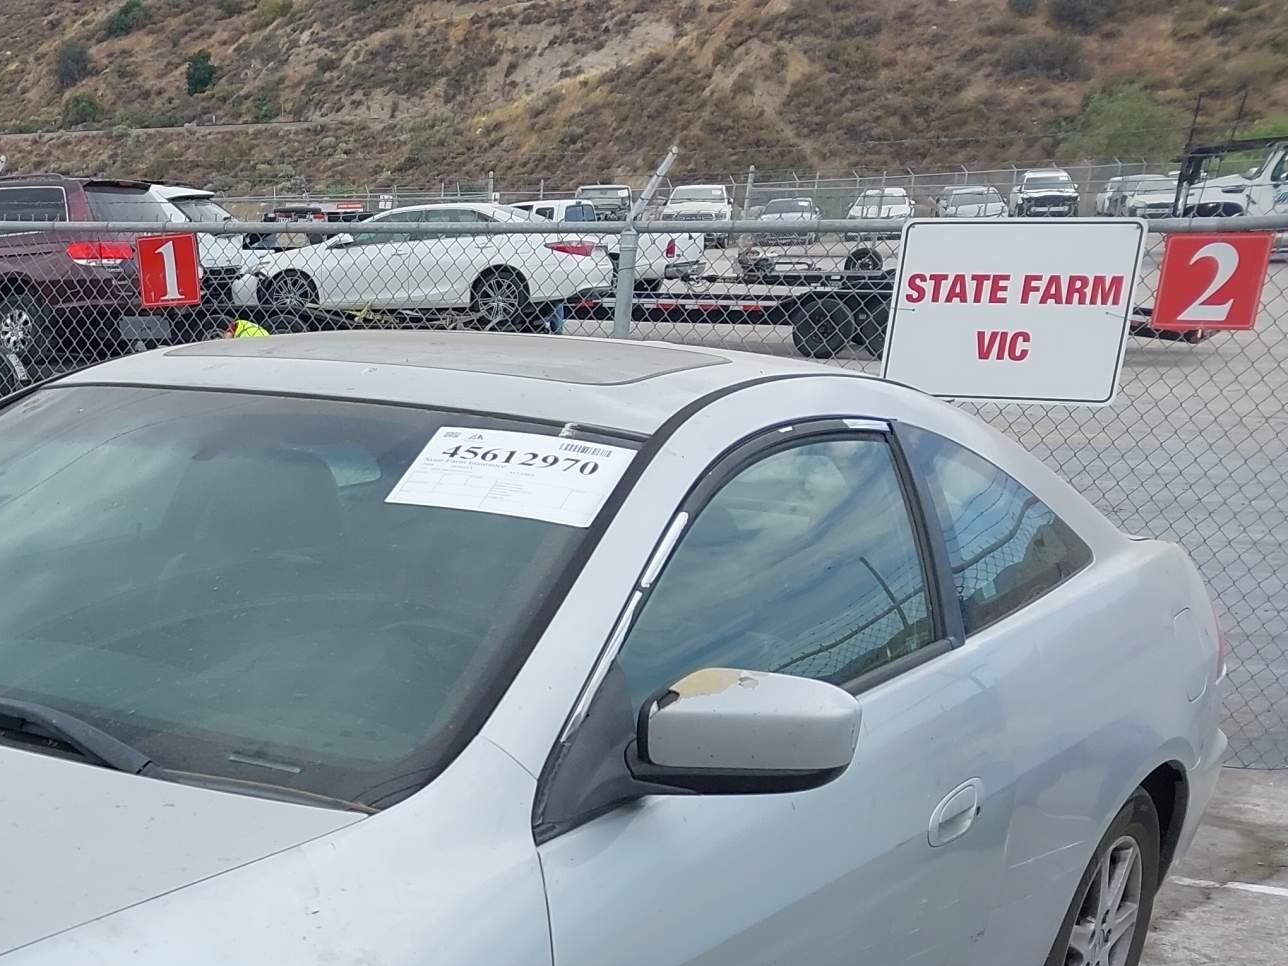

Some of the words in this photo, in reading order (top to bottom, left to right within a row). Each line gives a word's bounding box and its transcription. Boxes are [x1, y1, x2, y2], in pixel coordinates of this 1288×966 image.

[153, 240, 185, 302] 1
[1176, 242, 1240, 322] 2
[905, 273, 1010, 304] STATE
[1020, 275, 1124, 306] FARM
[976, 331, 1031, 361] VIC
[442, 444, 599, 476] 45612970
